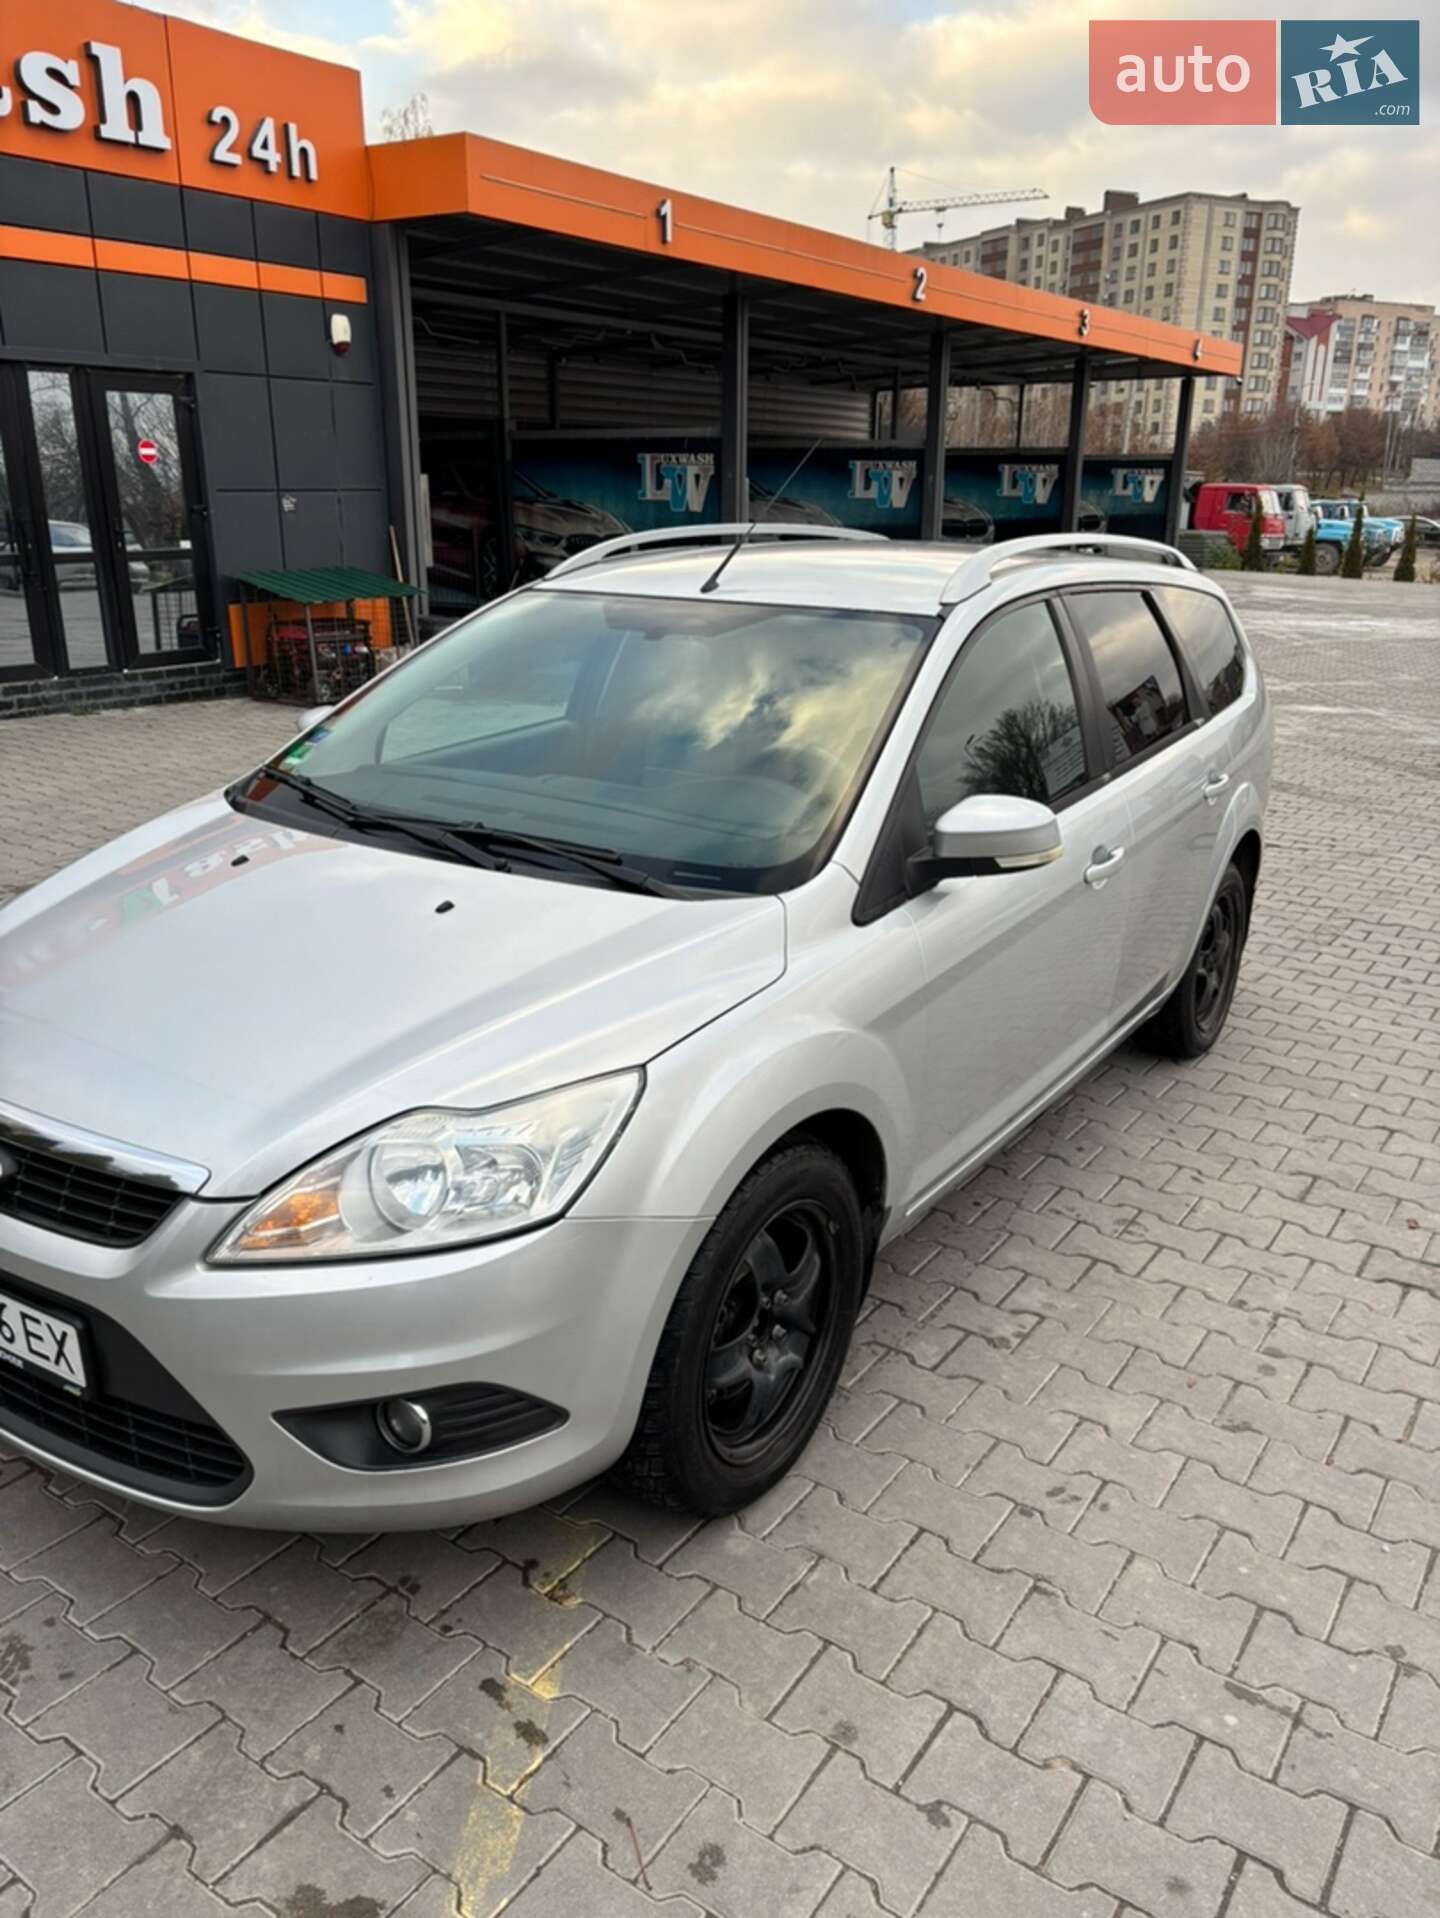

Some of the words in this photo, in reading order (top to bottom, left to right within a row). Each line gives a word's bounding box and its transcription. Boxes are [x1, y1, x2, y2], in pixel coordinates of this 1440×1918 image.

[0, 41, 172, 152] sh
[207, 105, 319, 182] 24h
[657, 199, 672, 244] 1
[913, 267, 927, 302] 2
[1079, 309, 1090, 336] 3
[20, 1310, 76, 1375] EX
